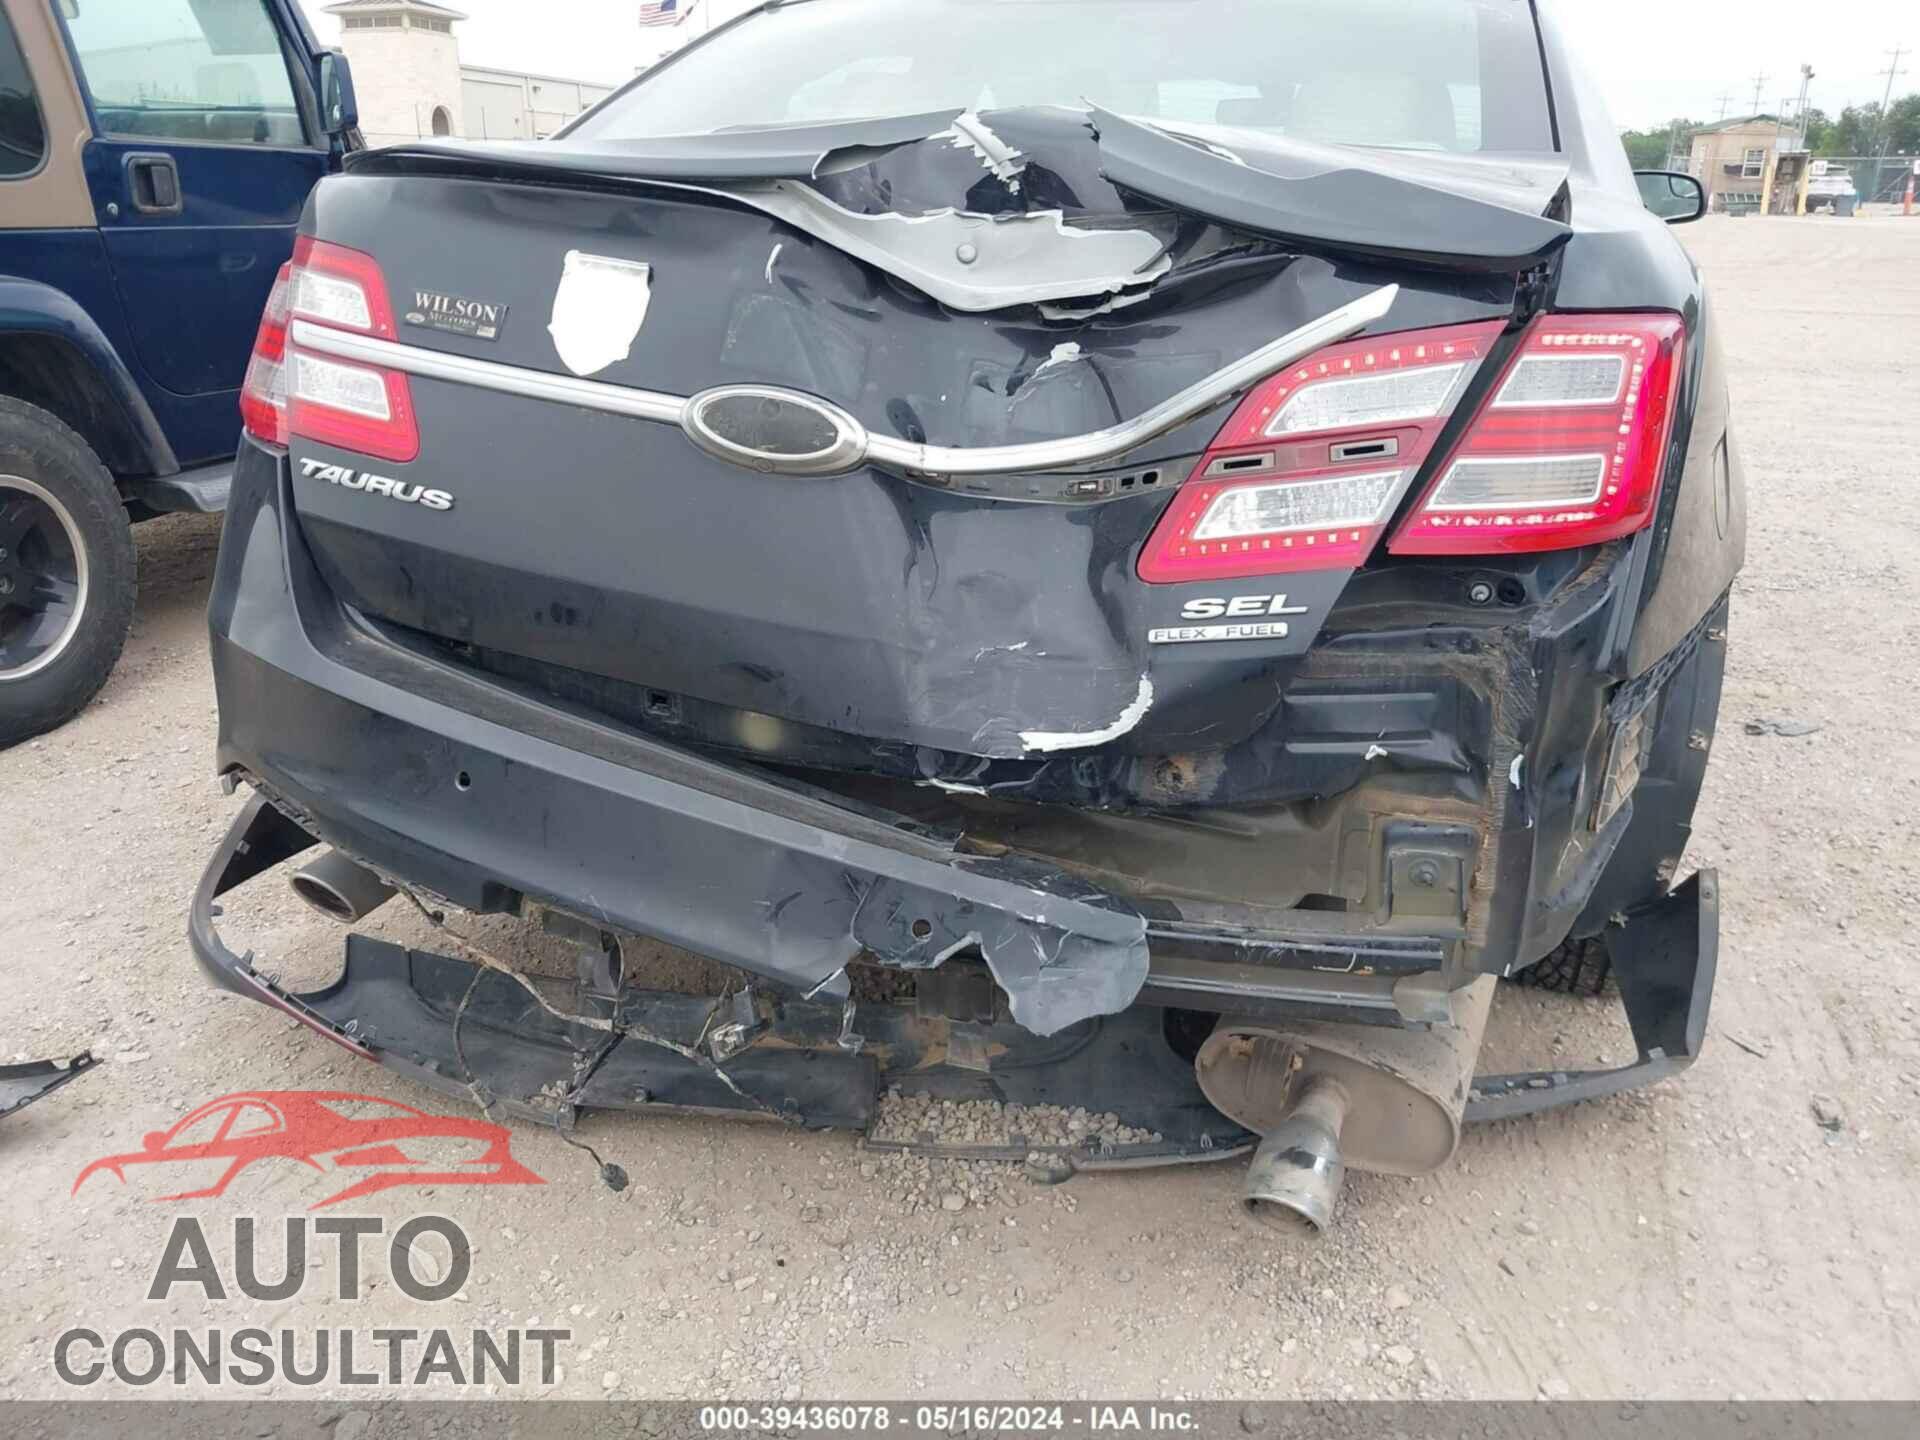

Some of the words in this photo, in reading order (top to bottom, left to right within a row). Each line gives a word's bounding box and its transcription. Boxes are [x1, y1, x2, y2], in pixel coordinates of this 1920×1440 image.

[415, 291, 498, 322] WILSON
[299, 457, 455, 511] TAURUS
[1180, 594, 1309, 620] SEL
[1153, 628, 1207, 641] FLEX
[1225, 624, 1282, 638] FUEL
